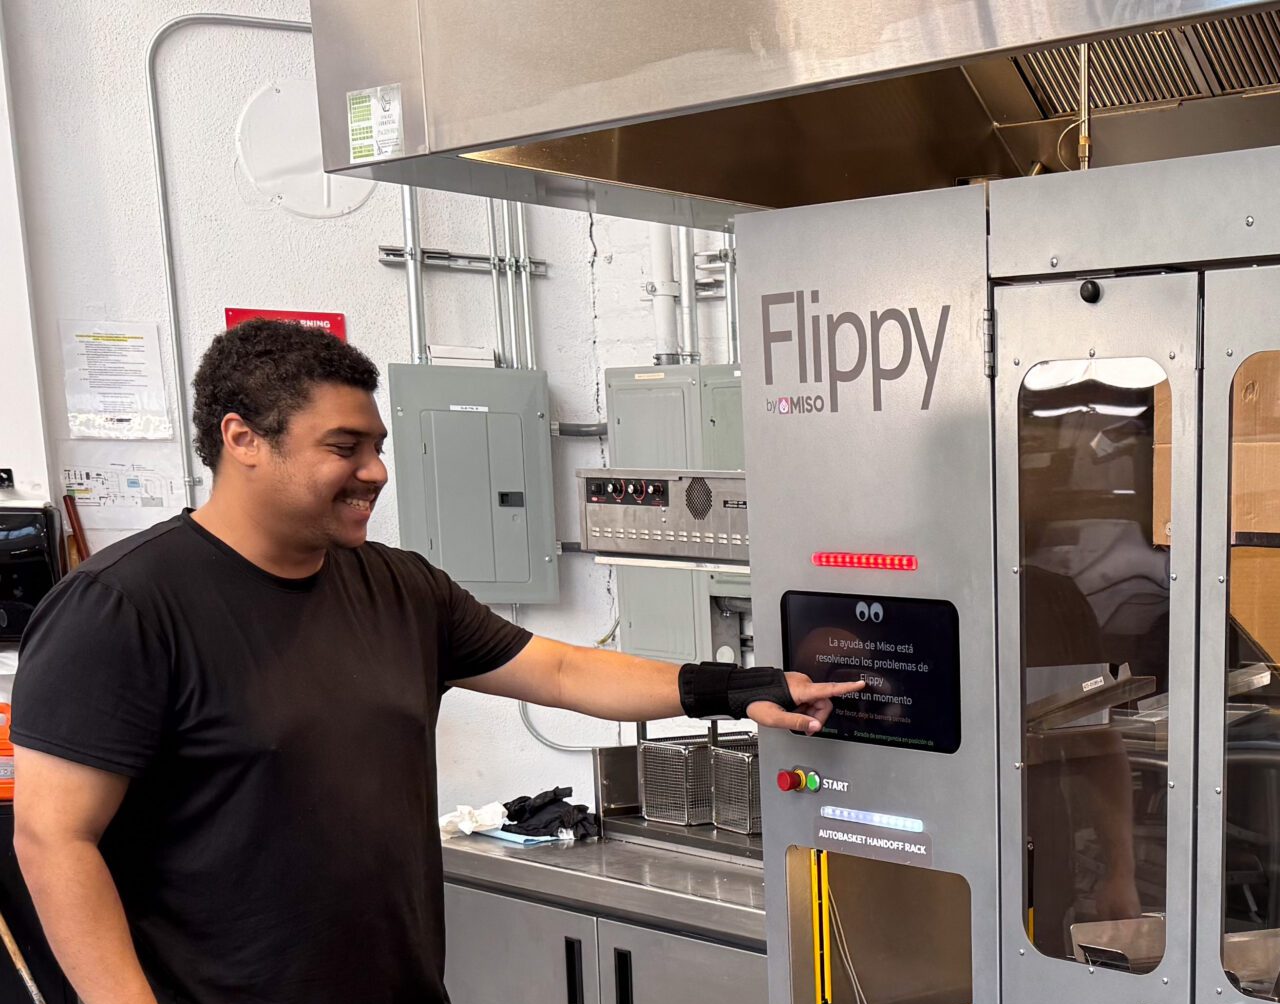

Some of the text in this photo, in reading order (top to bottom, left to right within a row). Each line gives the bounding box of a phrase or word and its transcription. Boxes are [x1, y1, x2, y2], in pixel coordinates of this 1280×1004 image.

[761, 290, 951, 412] Flippy
[766, 395, 824, 413] by MISO
[829, 637, 914, 654] La ayuda de Miso está
[816, 653, 929, 672] resolviendo los problemas de
[873, 693, 913, 705] momento
[823, 779, 848, 791] START
[818, 829, 926, 854] AUTOBASKET HANDOFF RACK
